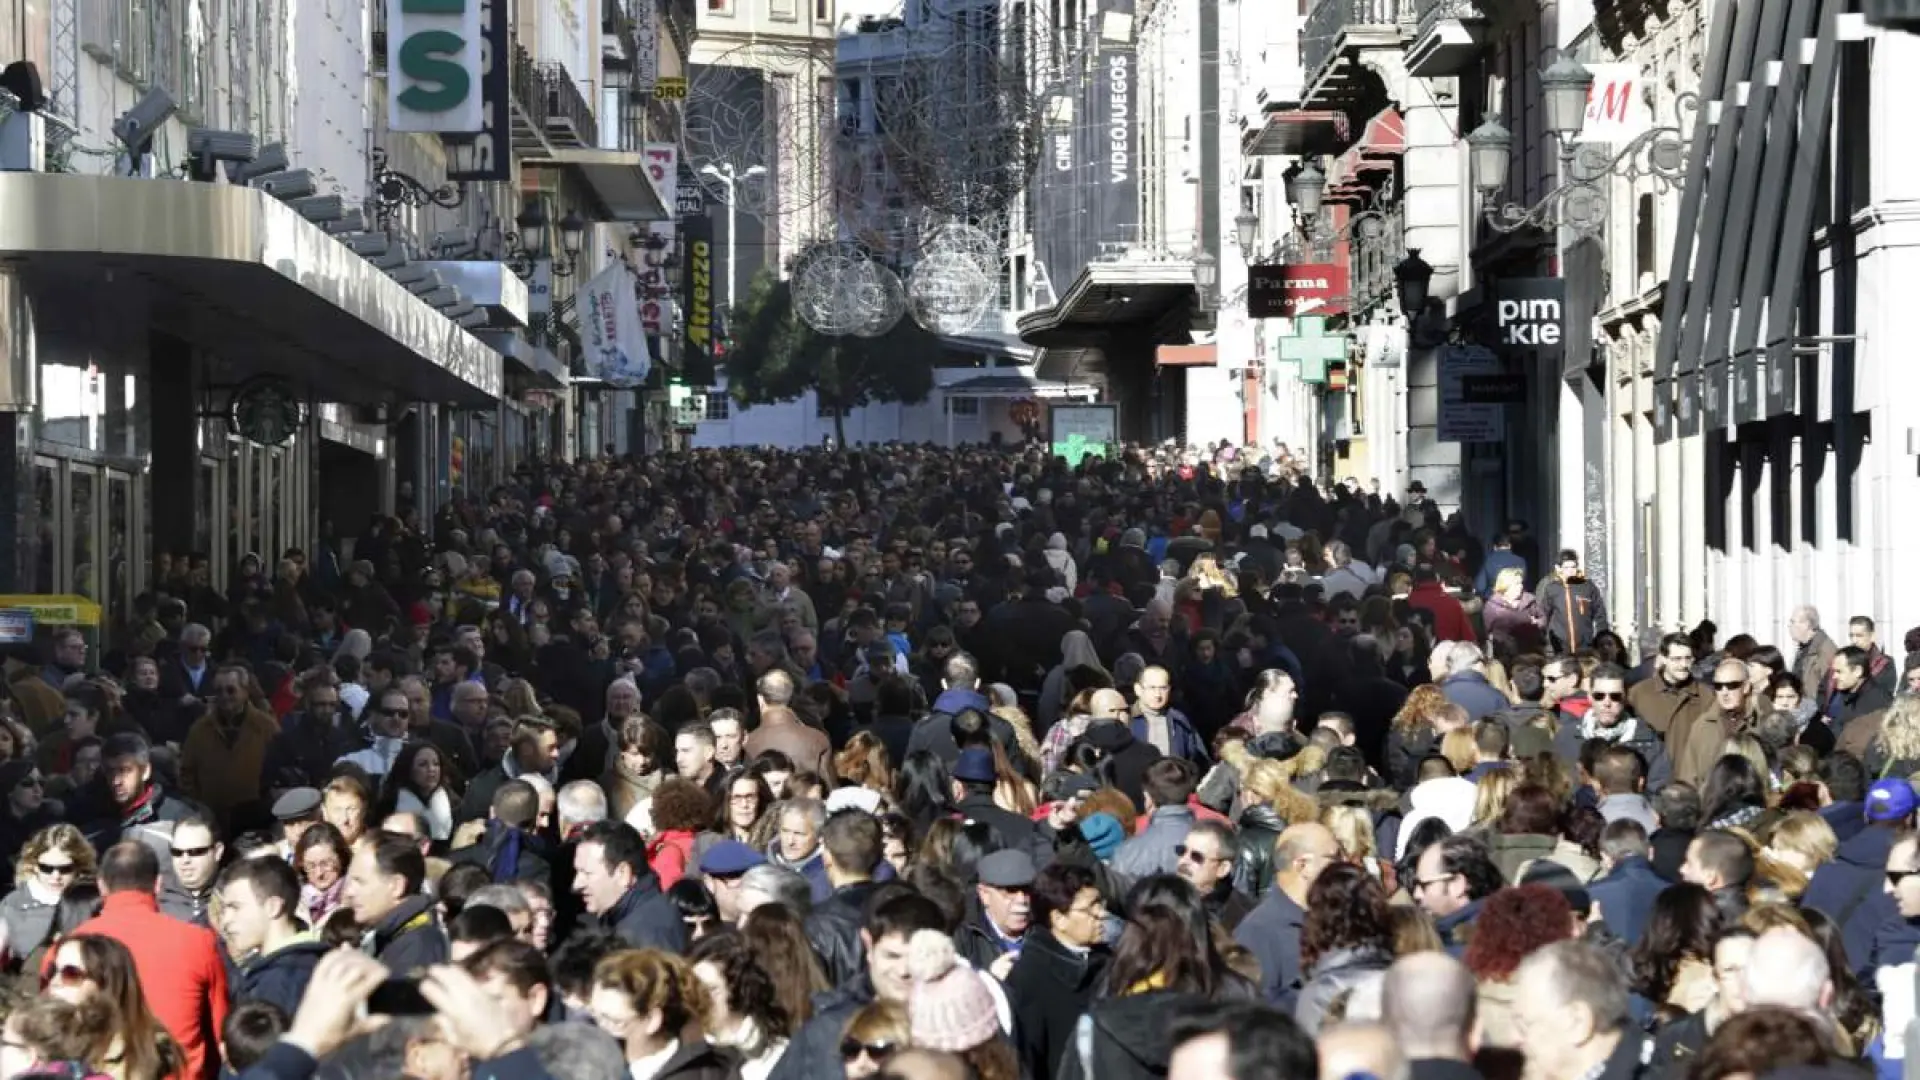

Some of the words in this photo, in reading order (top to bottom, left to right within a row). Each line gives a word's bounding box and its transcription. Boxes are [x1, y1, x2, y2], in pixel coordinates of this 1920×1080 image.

[1110, 55, 1128, 184] VIDEOJUEGOS
[1055, 134, 1071, 172] CINE
[1255, 277, 1329, 289] Parma
[1498, 298, 1560, 327] pim
